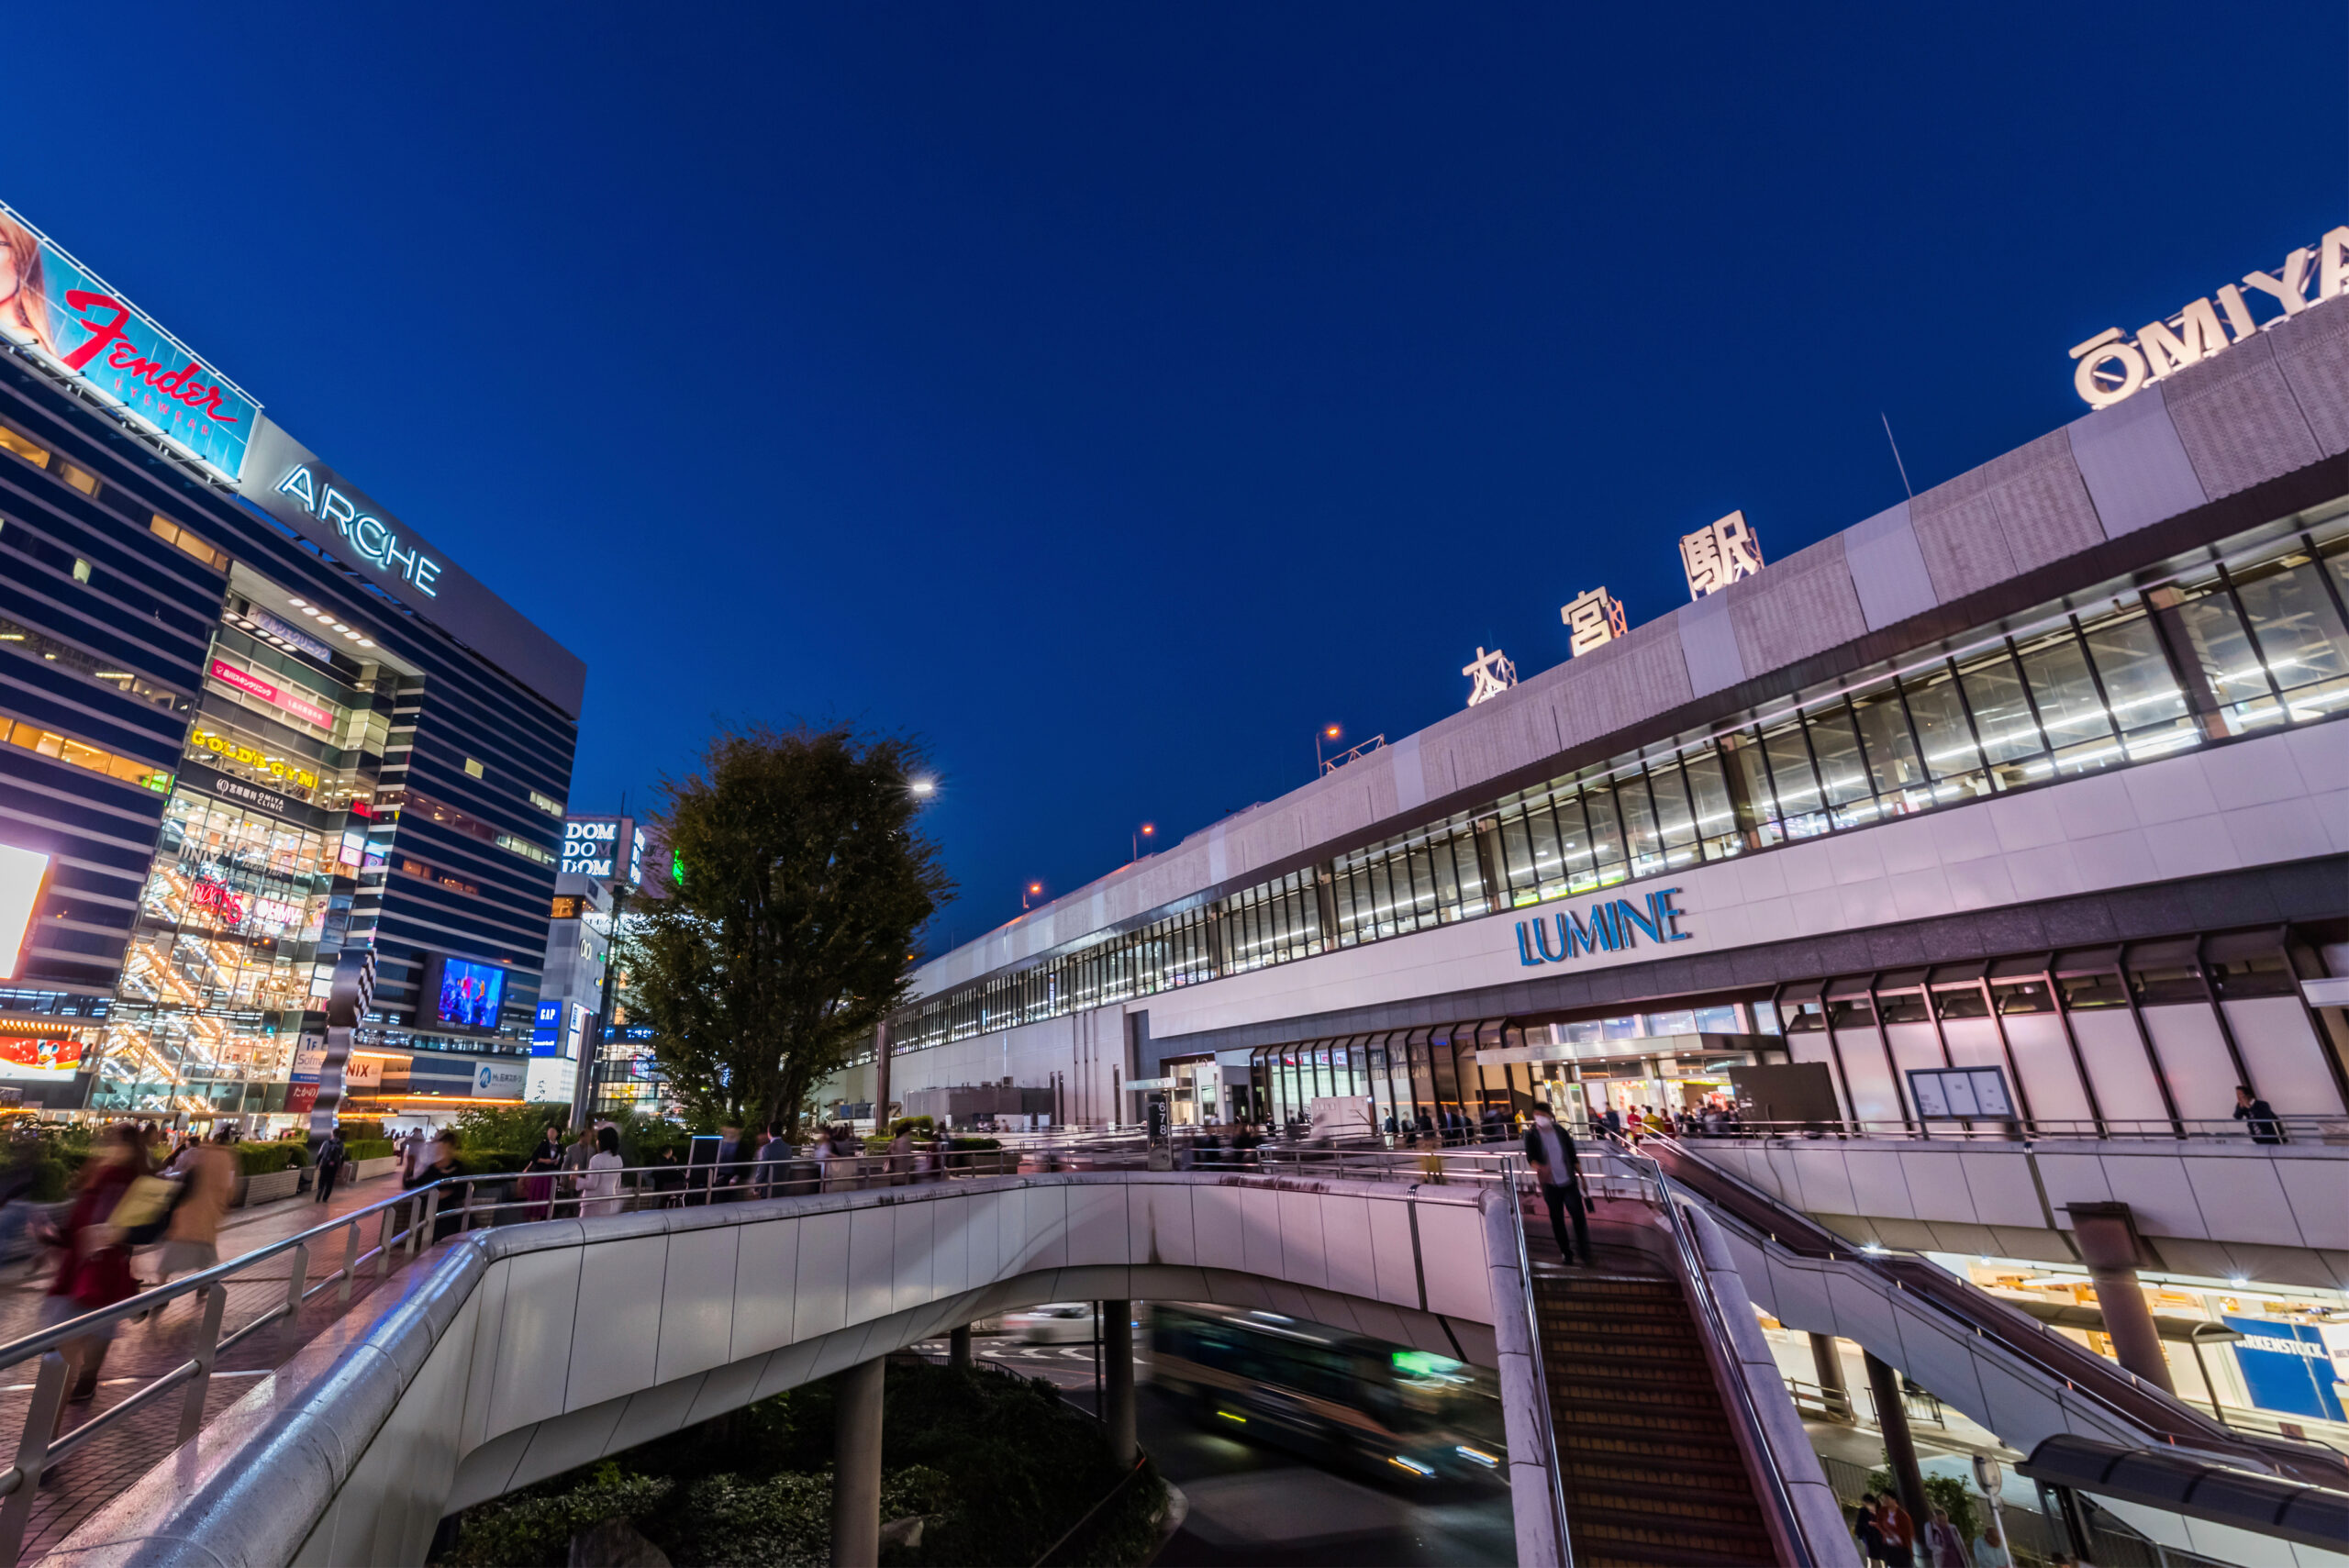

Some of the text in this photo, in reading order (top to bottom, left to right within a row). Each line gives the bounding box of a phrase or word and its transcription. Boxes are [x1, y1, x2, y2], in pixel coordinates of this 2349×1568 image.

[61, 289, 239, 423] Fender
[115, 378, 209, 436] EYEWEAR
[281, 466, 441, 597] ARCHE
[191, 729, 315, 789] GOLD'S GYM
[257, 799, 284, 812] CLINIC
[258, 792, 284, 806] OMIYA
[565, 822, 617, 840] DOM
[562, 859, 612, 876] DOM
[1514, 887, 1687, 967] LUMINE
[540, 1008, 556, 1021] GAP
[306, 1037, 317, 1051] 1F
[1158, 1102, 1166, 1113] 6
[1159, 1113, 1166, 1124] 7
[1159, 1124, 1167, 1135] 8
